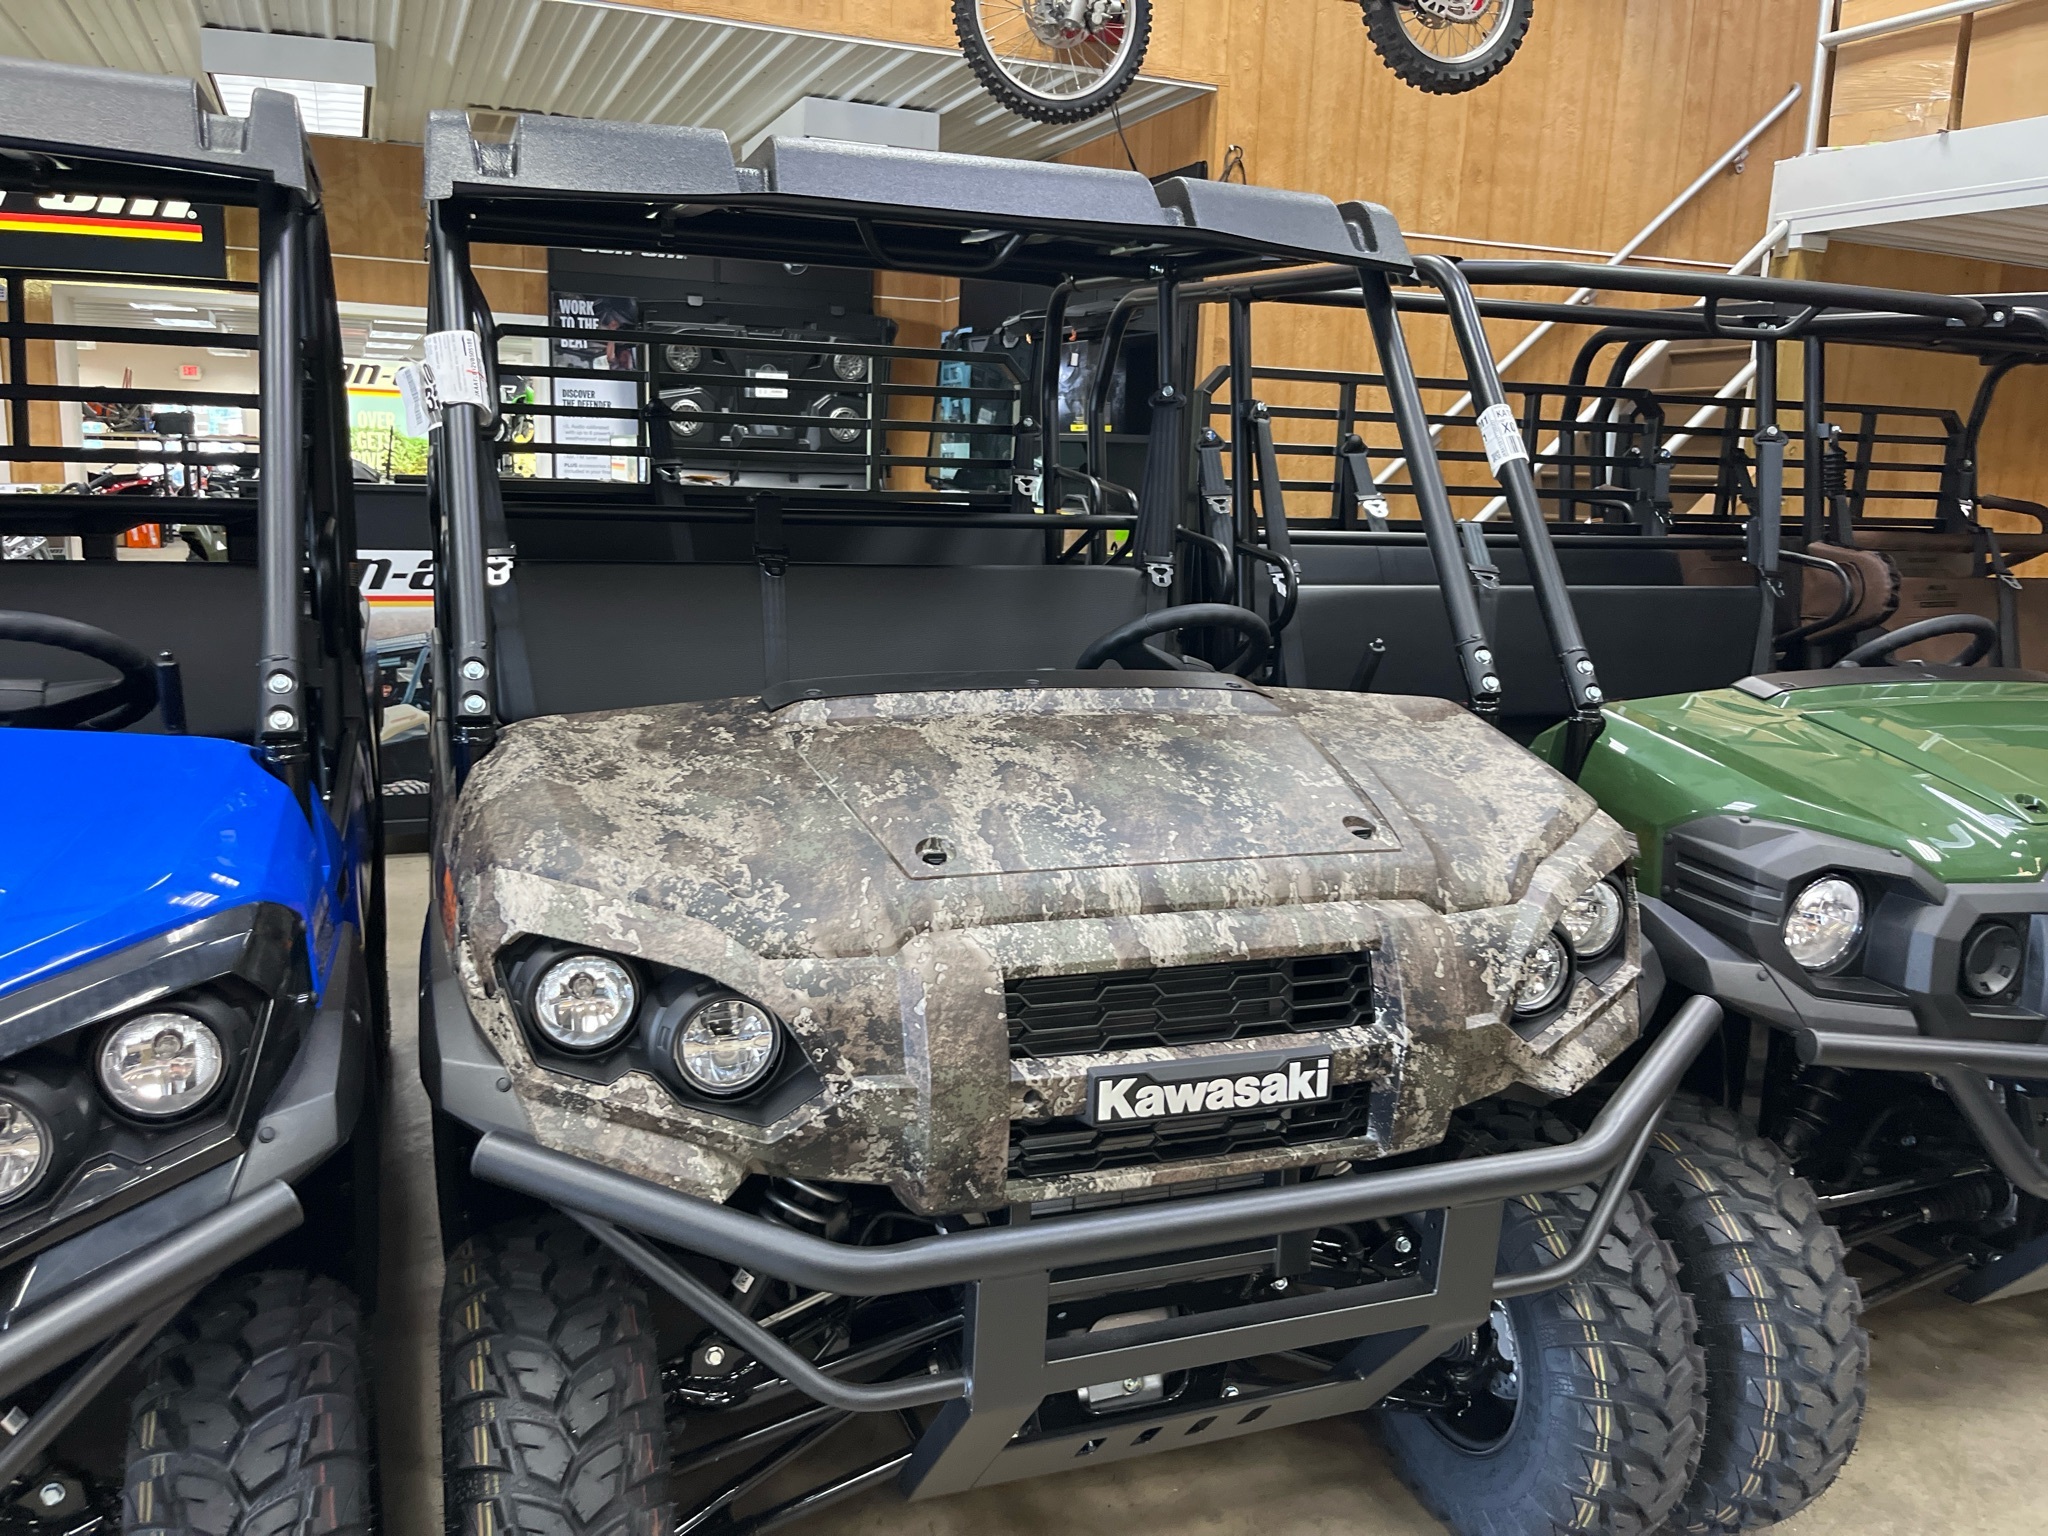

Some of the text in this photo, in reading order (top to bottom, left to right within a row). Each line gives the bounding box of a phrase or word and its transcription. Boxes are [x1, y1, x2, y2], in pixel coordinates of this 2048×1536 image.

[558, 298, 595, 316] WORK
[560, 316, 600, 330] TO THE
[562, 389, 596, 399] DISCOVER
[562, 399, 612, 409] THE DEFENDER
[357, 410, 396, 430] OVER
[1098, 1058, 1330, 1121] Kawasaki
